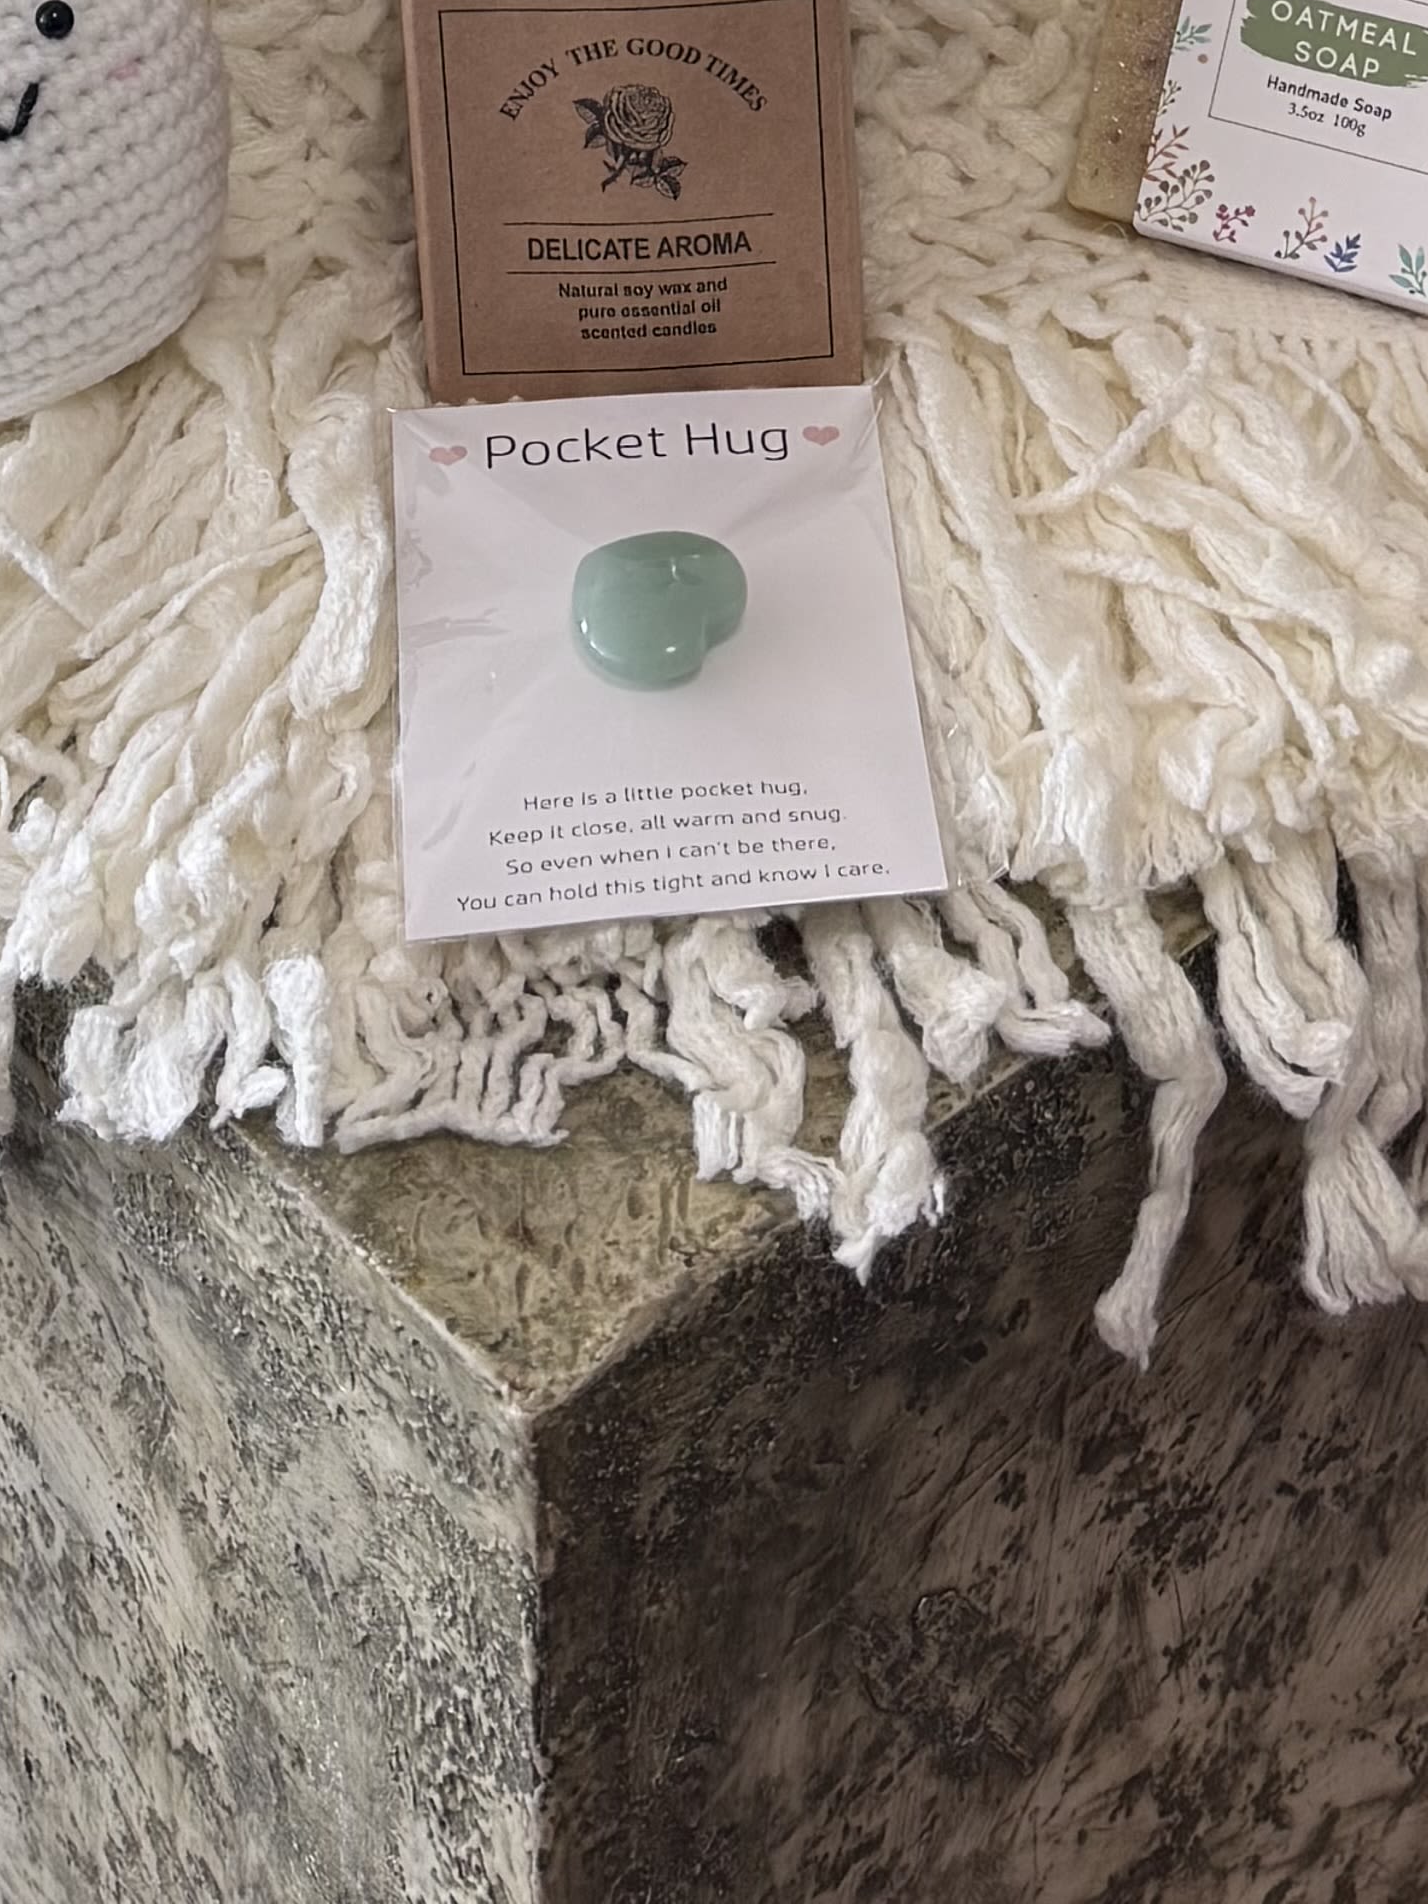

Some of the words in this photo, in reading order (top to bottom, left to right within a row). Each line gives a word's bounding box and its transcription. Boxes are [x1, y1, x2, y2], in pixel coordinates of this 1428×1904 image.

[1270, 0, 1417, 55] OATMEAL
[1293, 40, 1381, 78] SOAP
[499, 58, 560, 121] ENJOY
[565, 39, 619, 67] THE
[626, 37, 702, 65] GOOD
[705, 53, 768, 113] TIMES
[1266, 74, 1349, 108] Handmade
[1353, 97, 1392, 122] Soap
[1287, 102, 1325, 123] 3.5oz
[1333, 114, 1367, 138] 100g
[527, 237, 651, 261] DELICATE
[656, 230, 753, 259] AROMA
[558, 283, 619, 299] Natural
[623, 283, 654, 299] soy
[658, 282, 692, 296] wax
[696, 277, 728, 293] and
[578, 305, 616, 322] pure
[621, 300, 696, 319] essential
[701, 299, 721, 314] oil
[580, 324, 647, 340] scented
[652, 319, 717, 337] candles
[486, 427, 667, 469] Pocket
[685, 422, 789, 461] Hug
[524, 795, 574, 811] Here
[605, 792, 617, 804] a
[624, 787, 673, 803] little
[681, 782, 753, 800] pocket
[489, 829, 544, 846] Keep
[640, 815, 666, 831] all
[673, 813, 734, 829] warm
[741, 808, 782, 824] and
[506, 859, 533, 875] So
[540, 853, 593, 872] even
[599, 847, 660, 866] when
[679, 841, 730, 859] can't
[738, 840, 765, 854] be
[457, 895, 497, 912] You
[504, 892, 542, 907] can
[549, 883, 598, 903] hold
[605, 878, 646, 896] this
[653, 874, 705, 894] tight
[711, 869, 752, 887] and
[758, 867, 817, 883] know
